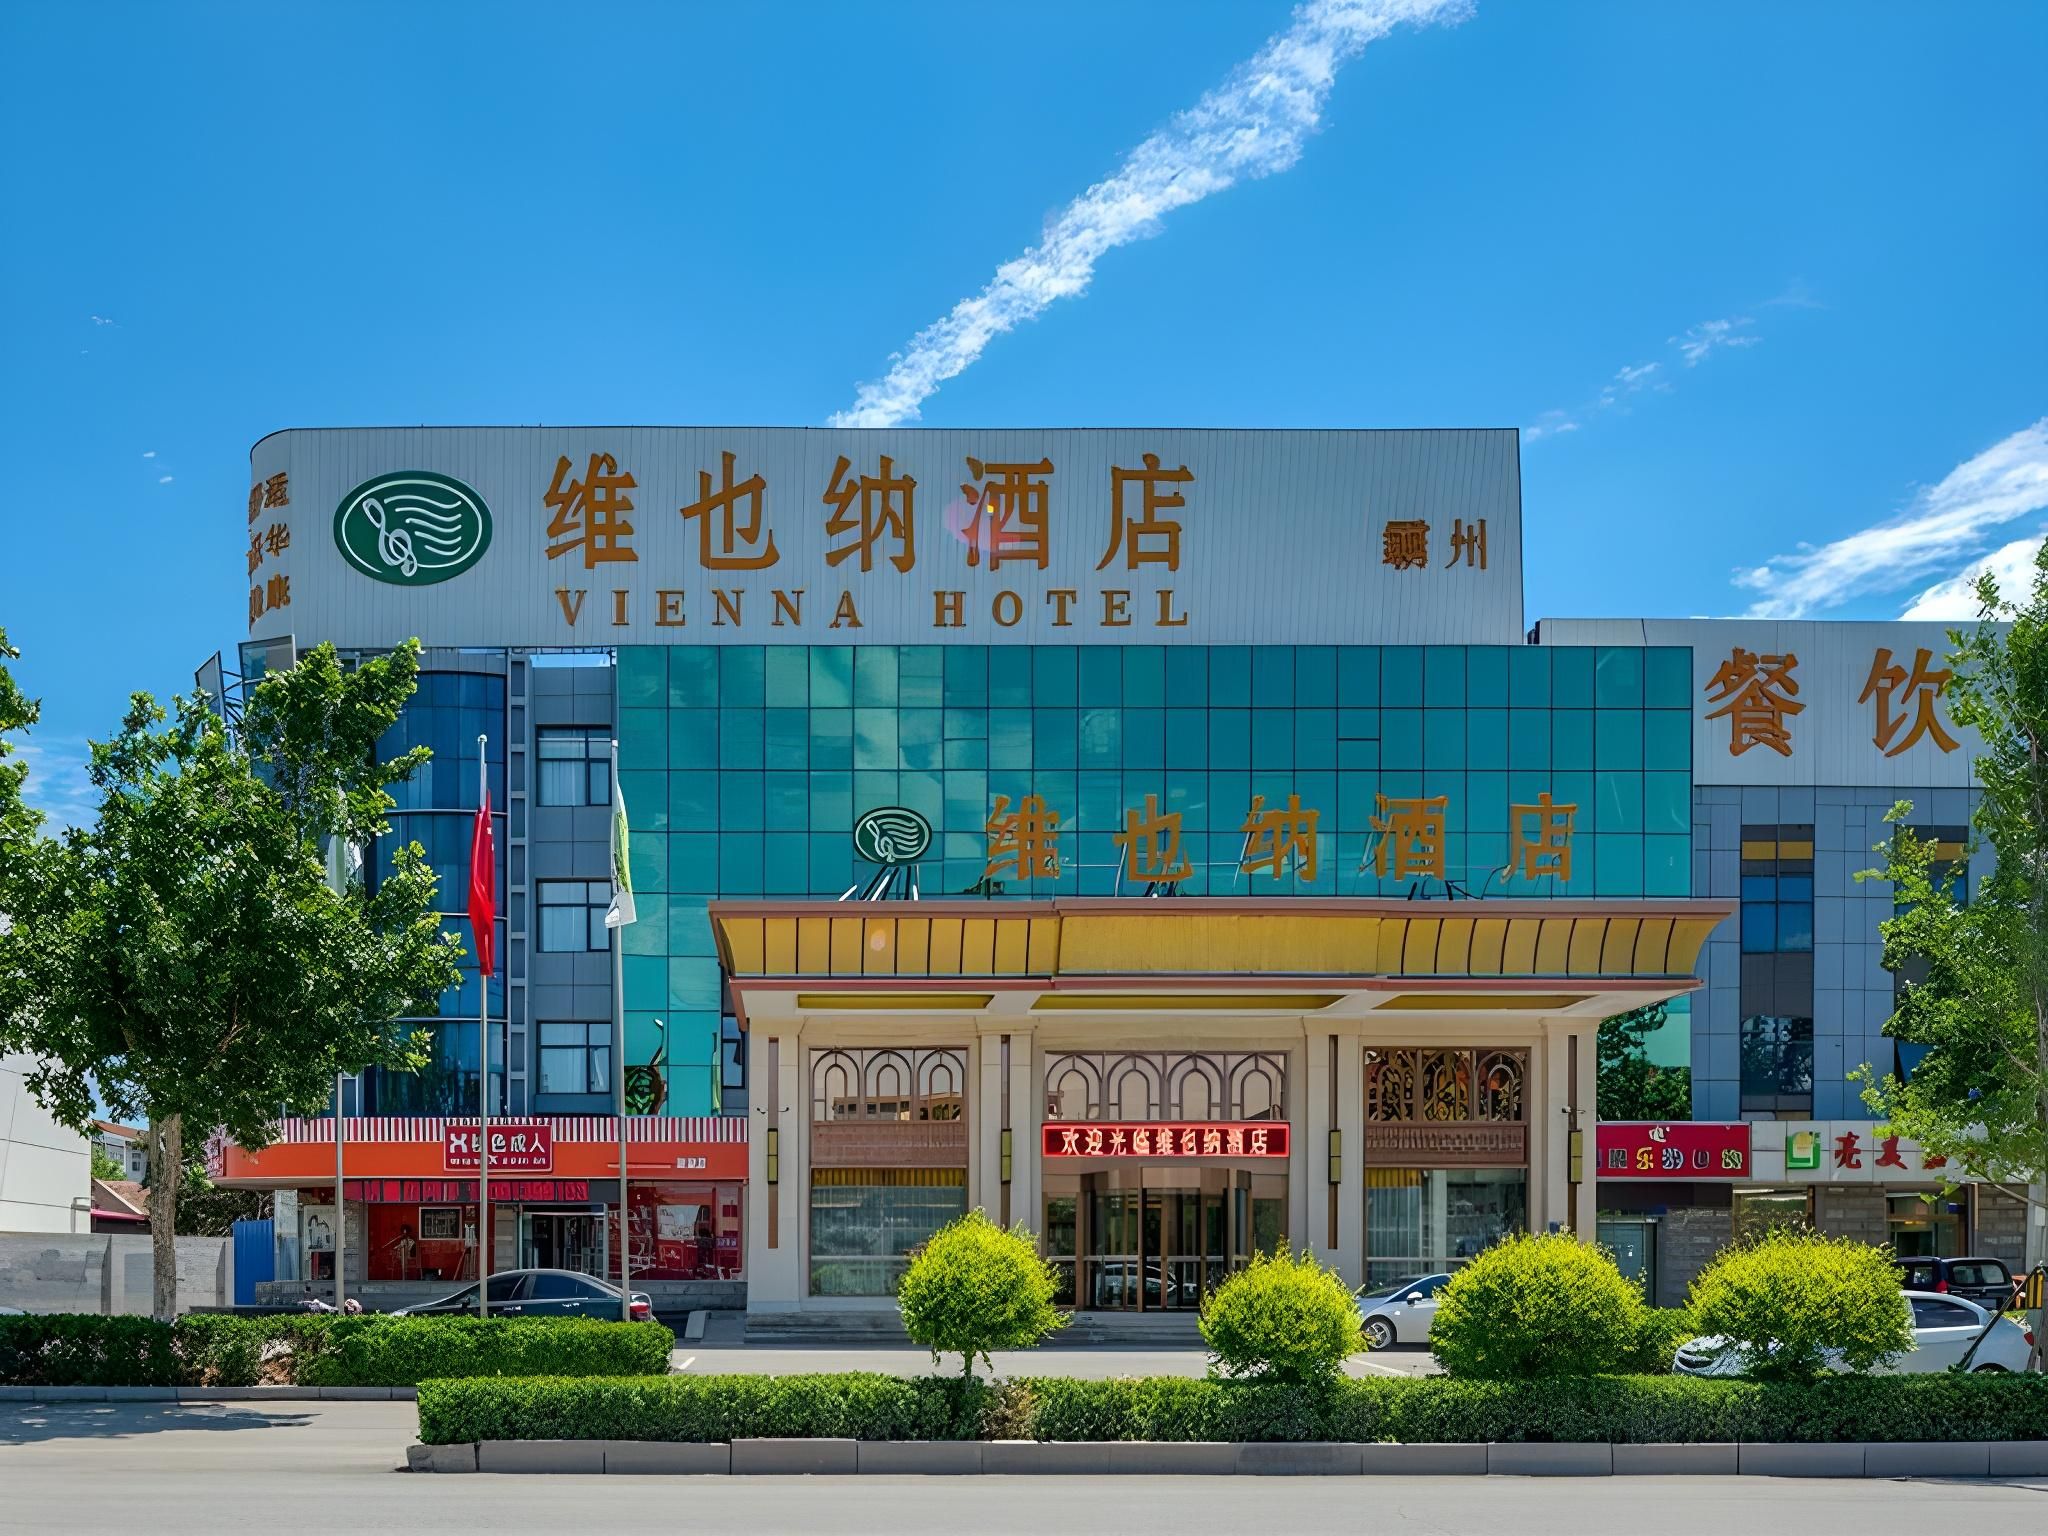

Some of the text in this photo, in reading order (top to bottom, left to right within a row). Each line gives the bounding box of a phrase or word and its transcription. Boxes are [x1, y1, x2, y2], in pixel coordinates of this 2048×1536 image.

[544, 451, 1195, 574] 维也纳酒店
[555, 588, 1189, 628] VIENNA HOTEL
[1704, 647, 1961, 758] 餐饮
[985, 793, 1578, 883] 维也纳酒店
